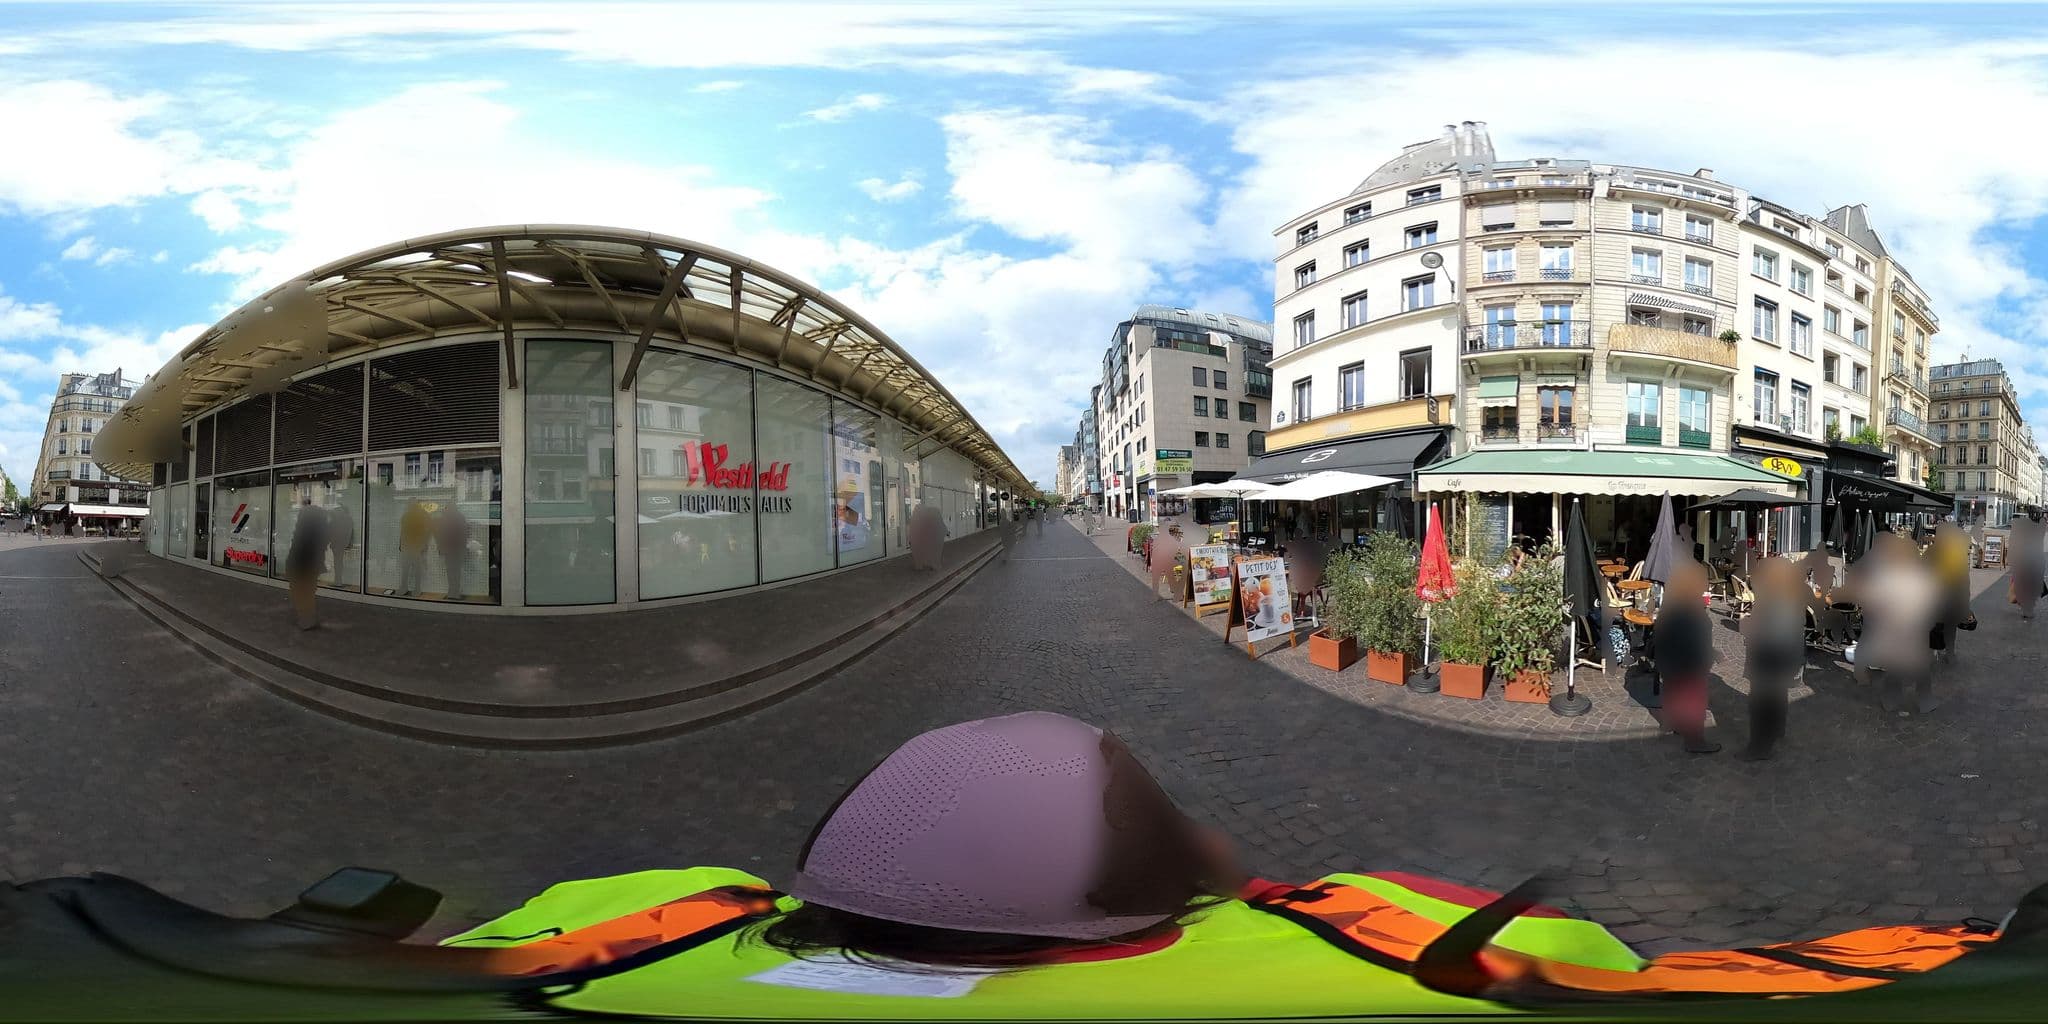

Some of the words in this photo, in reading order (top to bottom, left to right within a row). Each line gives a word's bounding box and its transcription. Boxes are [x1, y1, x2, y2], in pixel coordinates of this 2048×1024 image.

[682, 441, 791, 491] Westfeld
[680, 494, 726, 513] FORUM
[759, 496, 792, 513] ALLES
